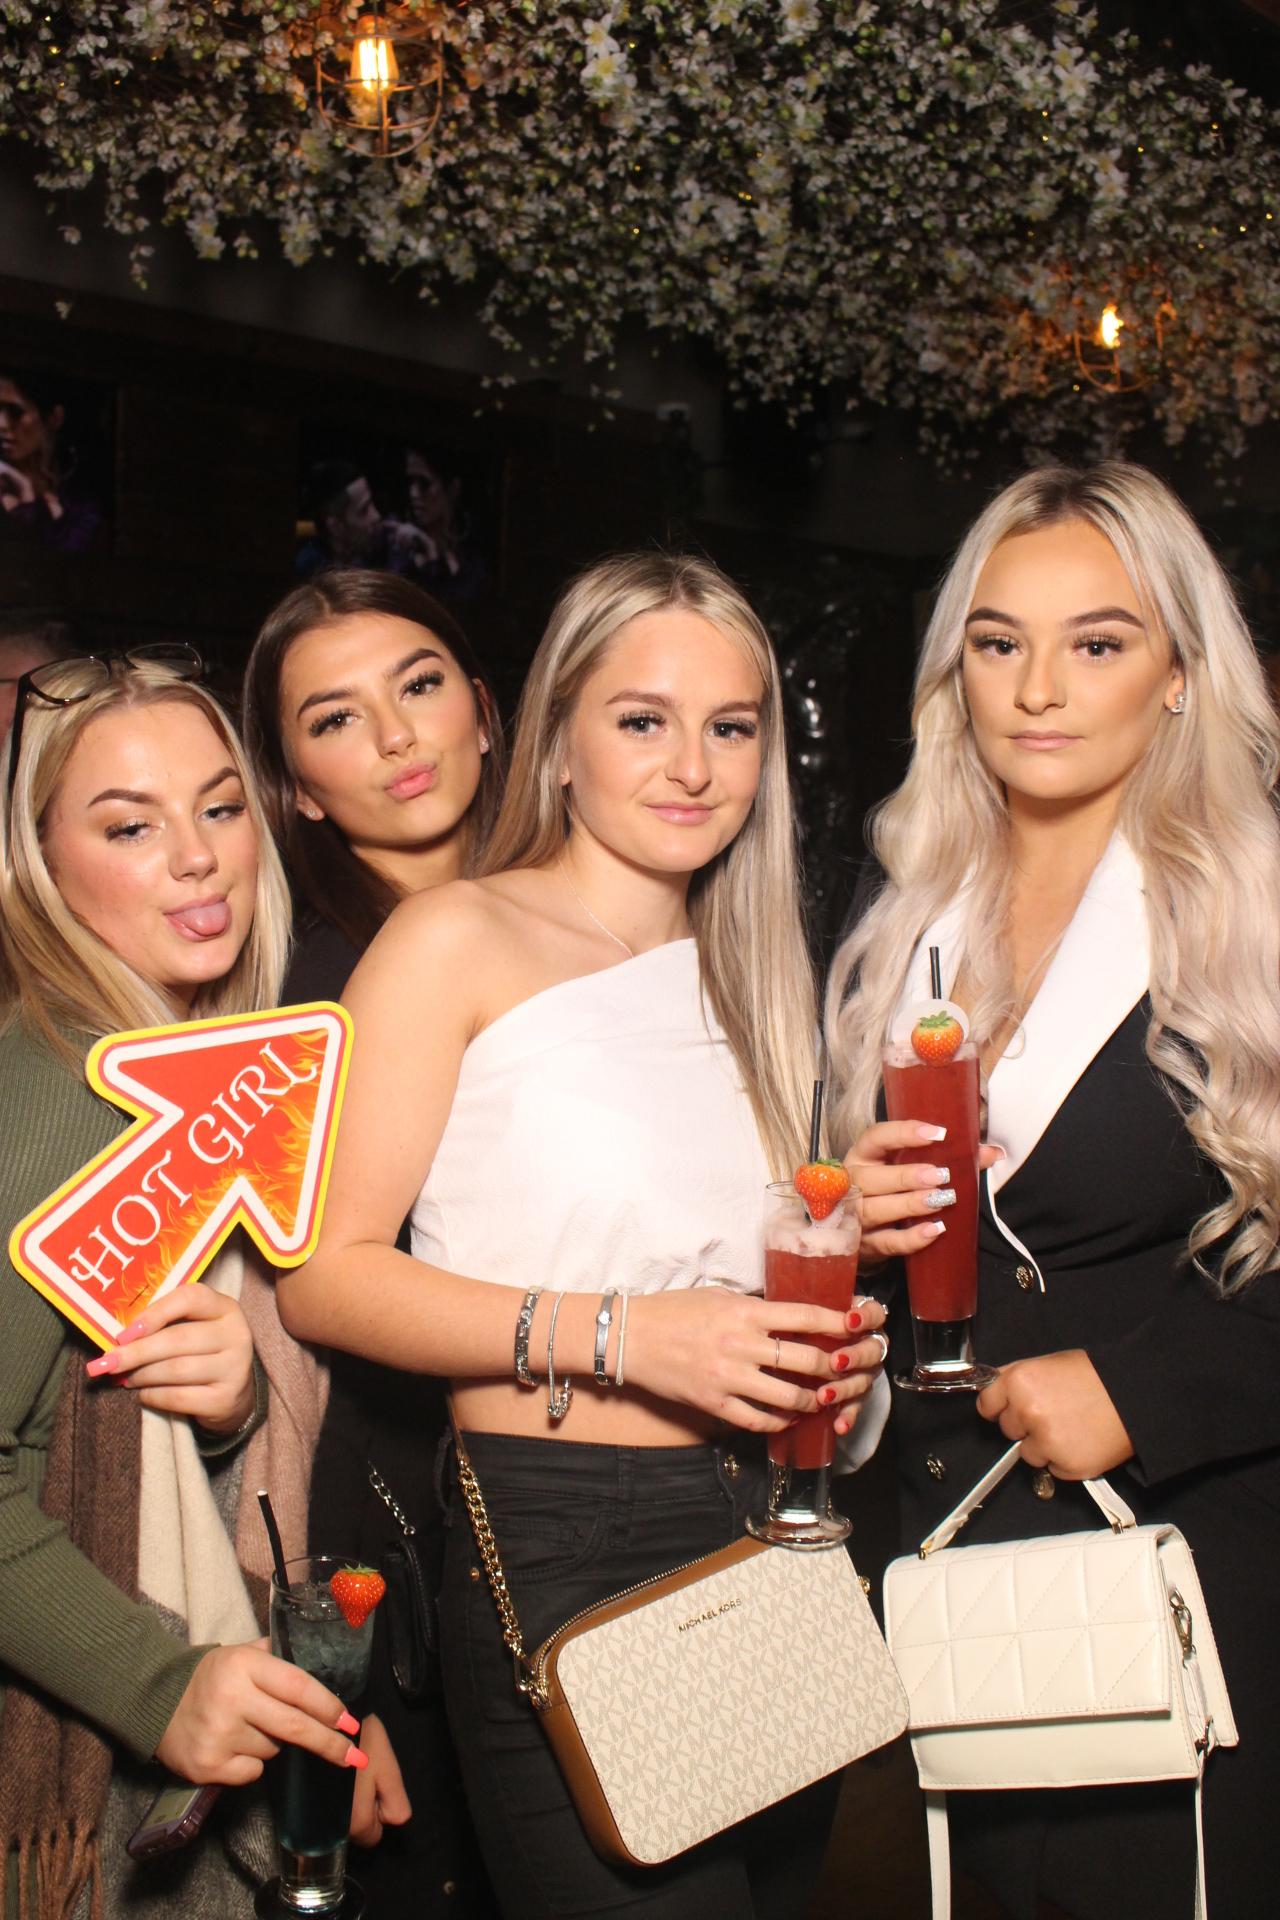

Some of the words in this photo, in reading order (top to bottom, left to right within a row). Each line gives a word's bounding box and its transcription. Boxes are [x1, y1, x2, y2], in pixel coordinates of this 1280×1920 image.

[68, 1149, 192, 1292] HOT
[187, 1042, 319, 1166] GIRL
[678, 1609, 717, 1632] MICHAEL
[719, 1598, 741, 1615] KORS
